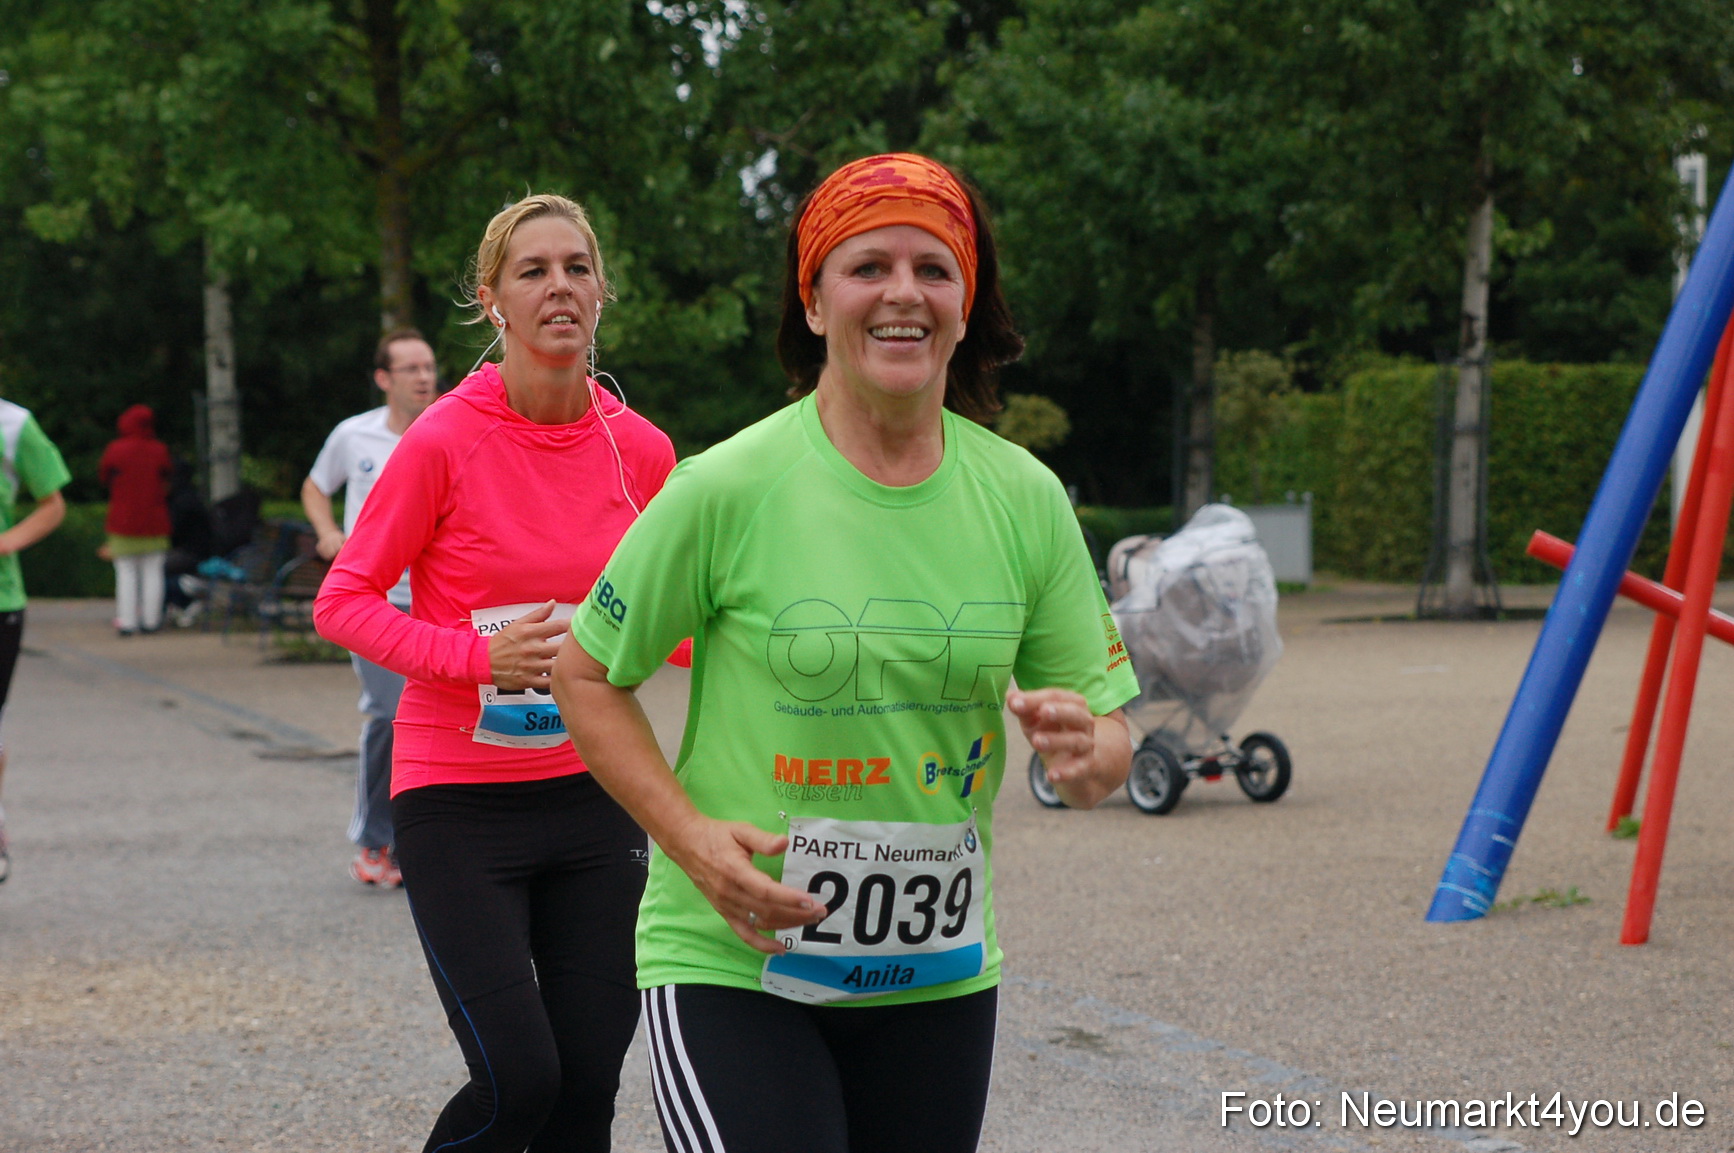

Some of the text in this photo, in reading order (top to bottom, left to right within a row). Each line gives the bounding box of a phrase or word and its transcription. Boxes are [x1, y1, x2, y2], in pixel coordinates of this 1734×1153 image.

[486, 693, 493, 703] C
[774, 701, 828, 717] Gebäude-
[832, 705, 854, 716] und
[524, 711, 565, 731] San
[774, 752, 891, 786] MERZ
[792, 835, 964, 863] PARTL Neumarkt
[801, 866, 973, 946] 2039
[784, 936, 794, 950] D
[842, 963, 916, 988] Anita
